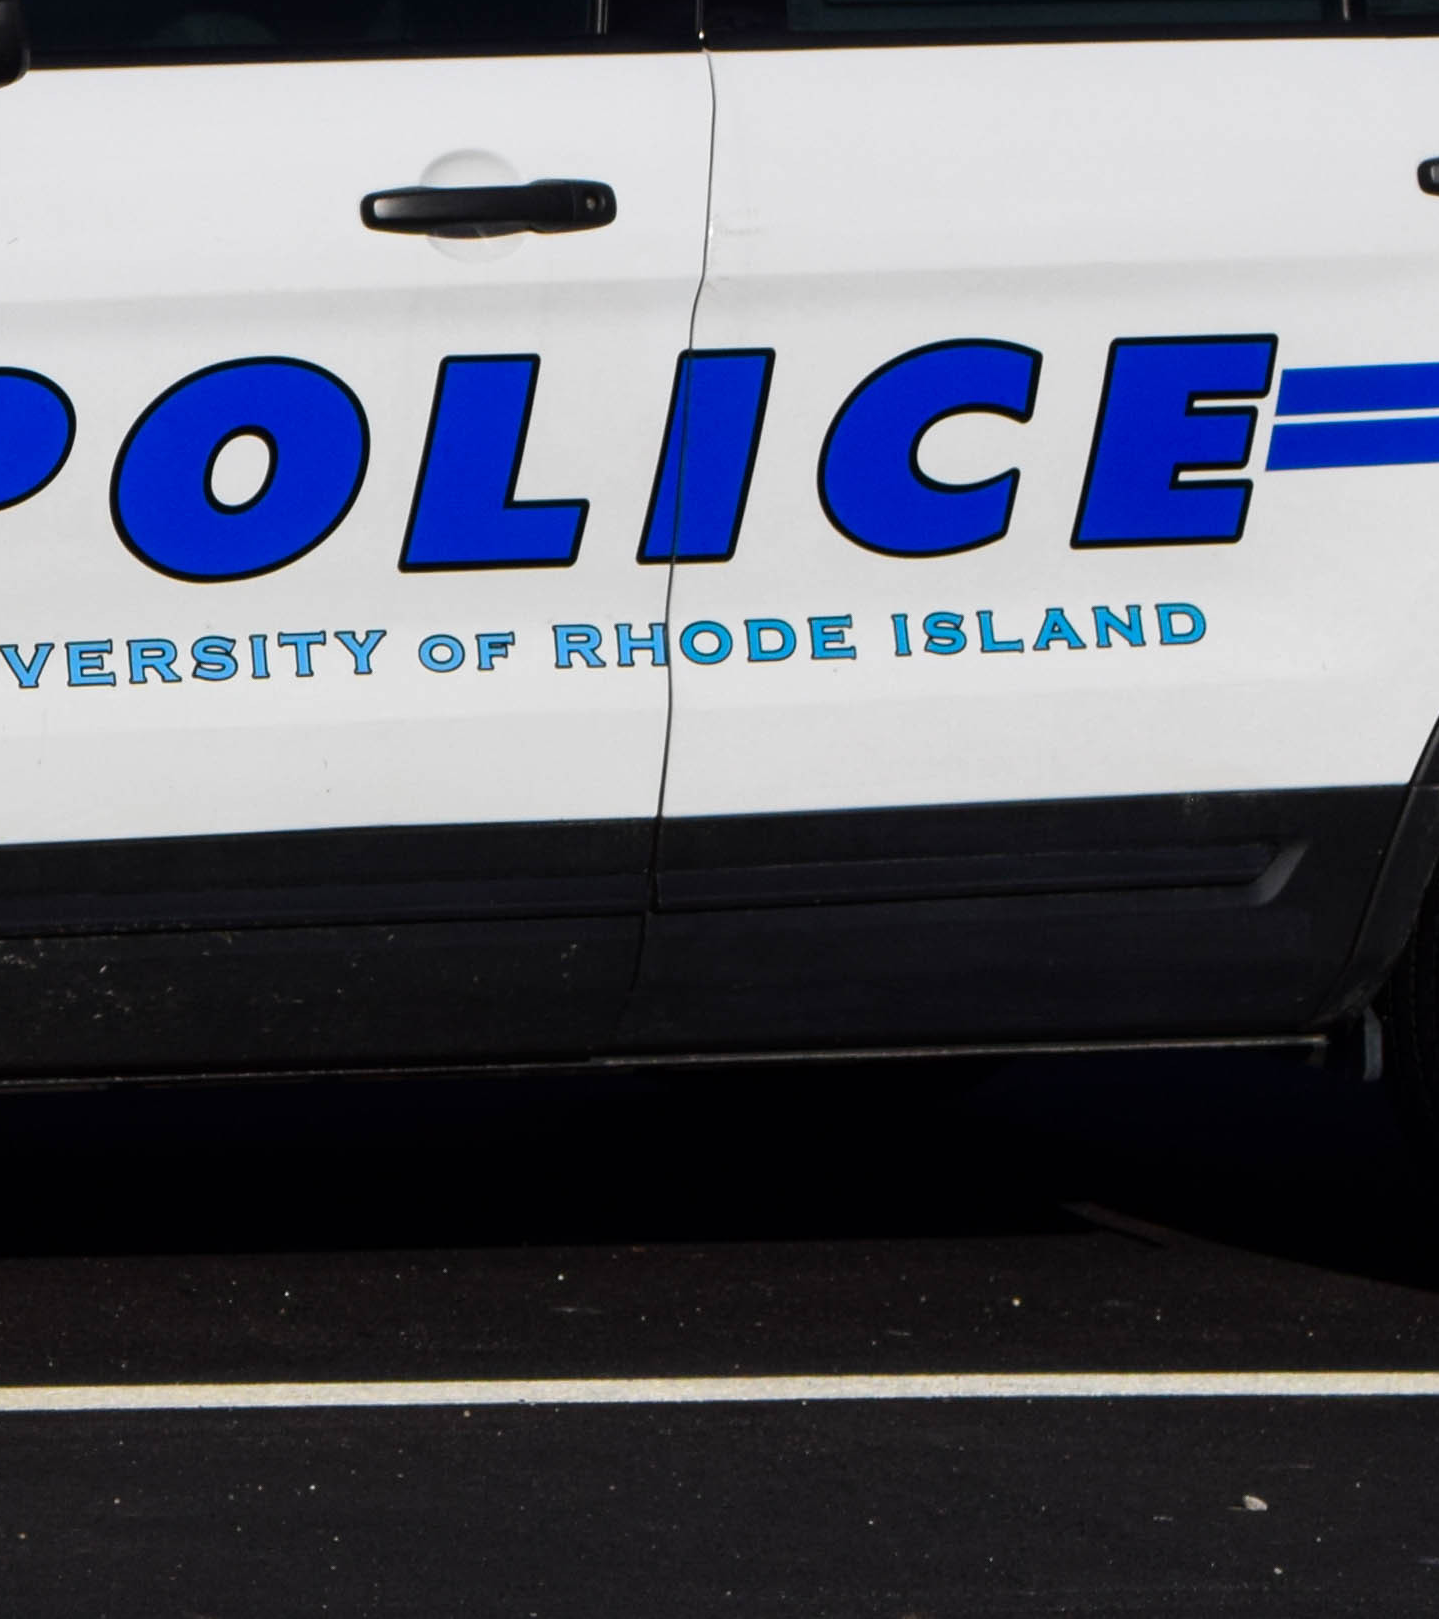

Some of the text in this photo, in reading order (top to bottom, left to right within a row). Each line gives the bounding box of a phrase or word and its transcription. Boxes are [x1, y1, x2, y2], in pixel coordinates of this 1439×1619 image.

[417, 631, 516, 673] OF
[551, 613, 857, 671] RHODE
[893, 602, 1208, 658] ISLAND
